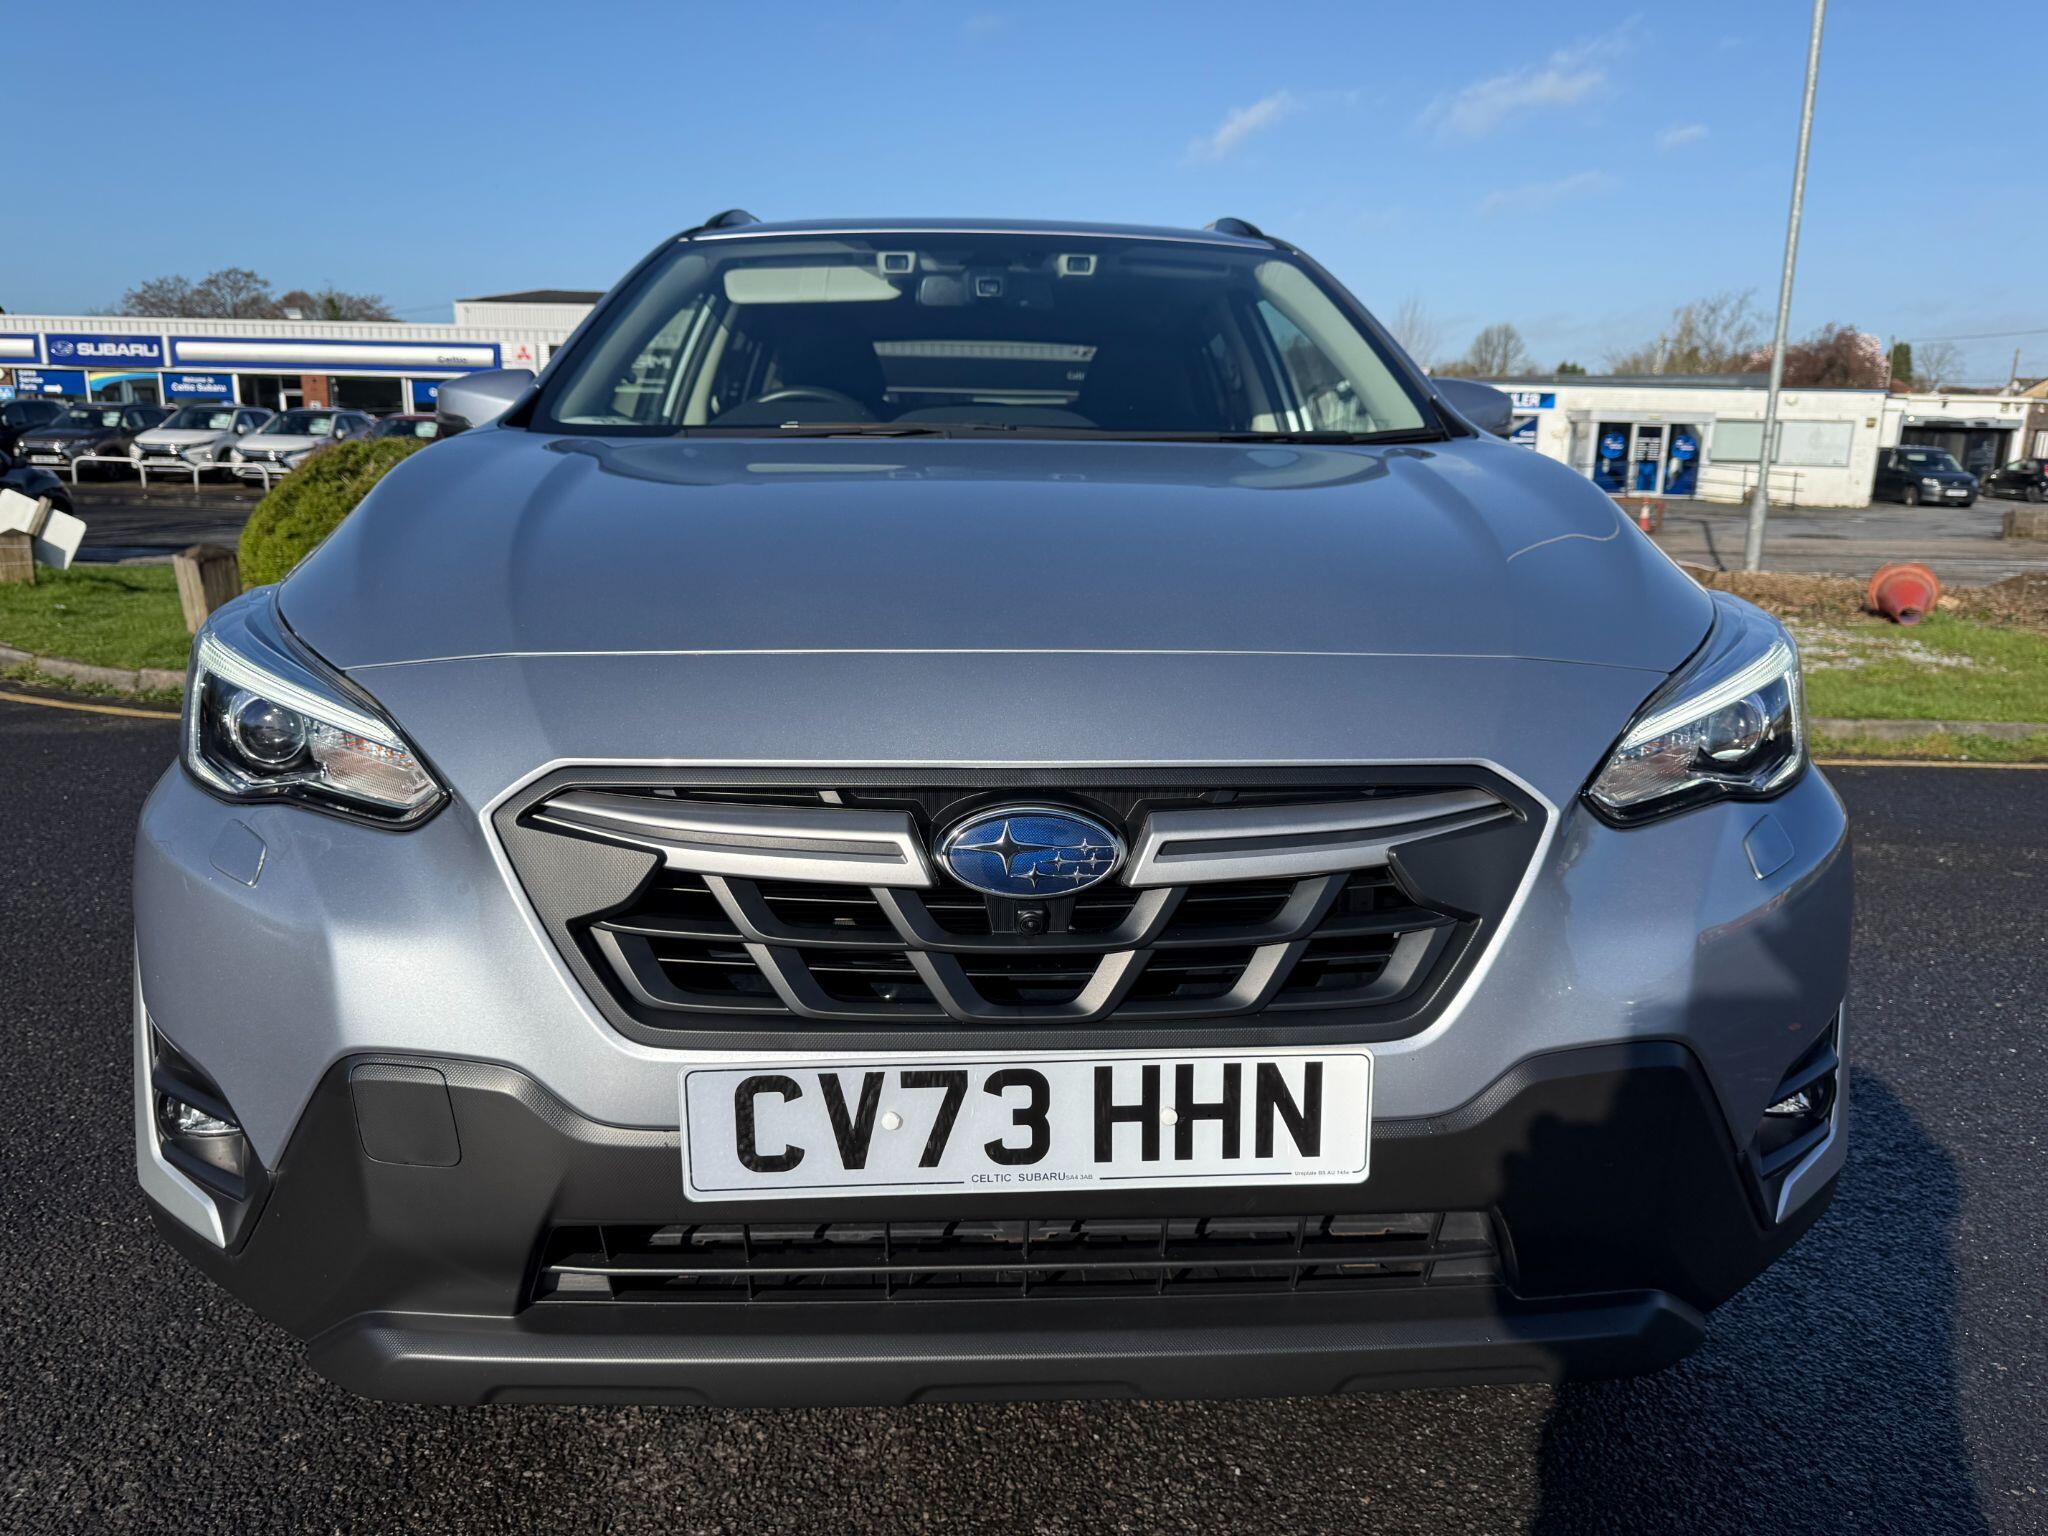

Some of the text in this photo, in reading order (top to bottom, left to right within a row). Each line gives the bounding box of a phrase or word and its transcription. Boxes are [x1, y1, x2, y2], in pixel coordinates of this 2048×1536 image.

[76, 342, 159, 357] SUBARU
[197, 383, 227, 392] Subaru
[735, 1062, 1323, 1173] CV73 HHN
[971, 1173, 1012, 1183] CELTIC
[1018, 1172, 1066, 1182] SUBARU
